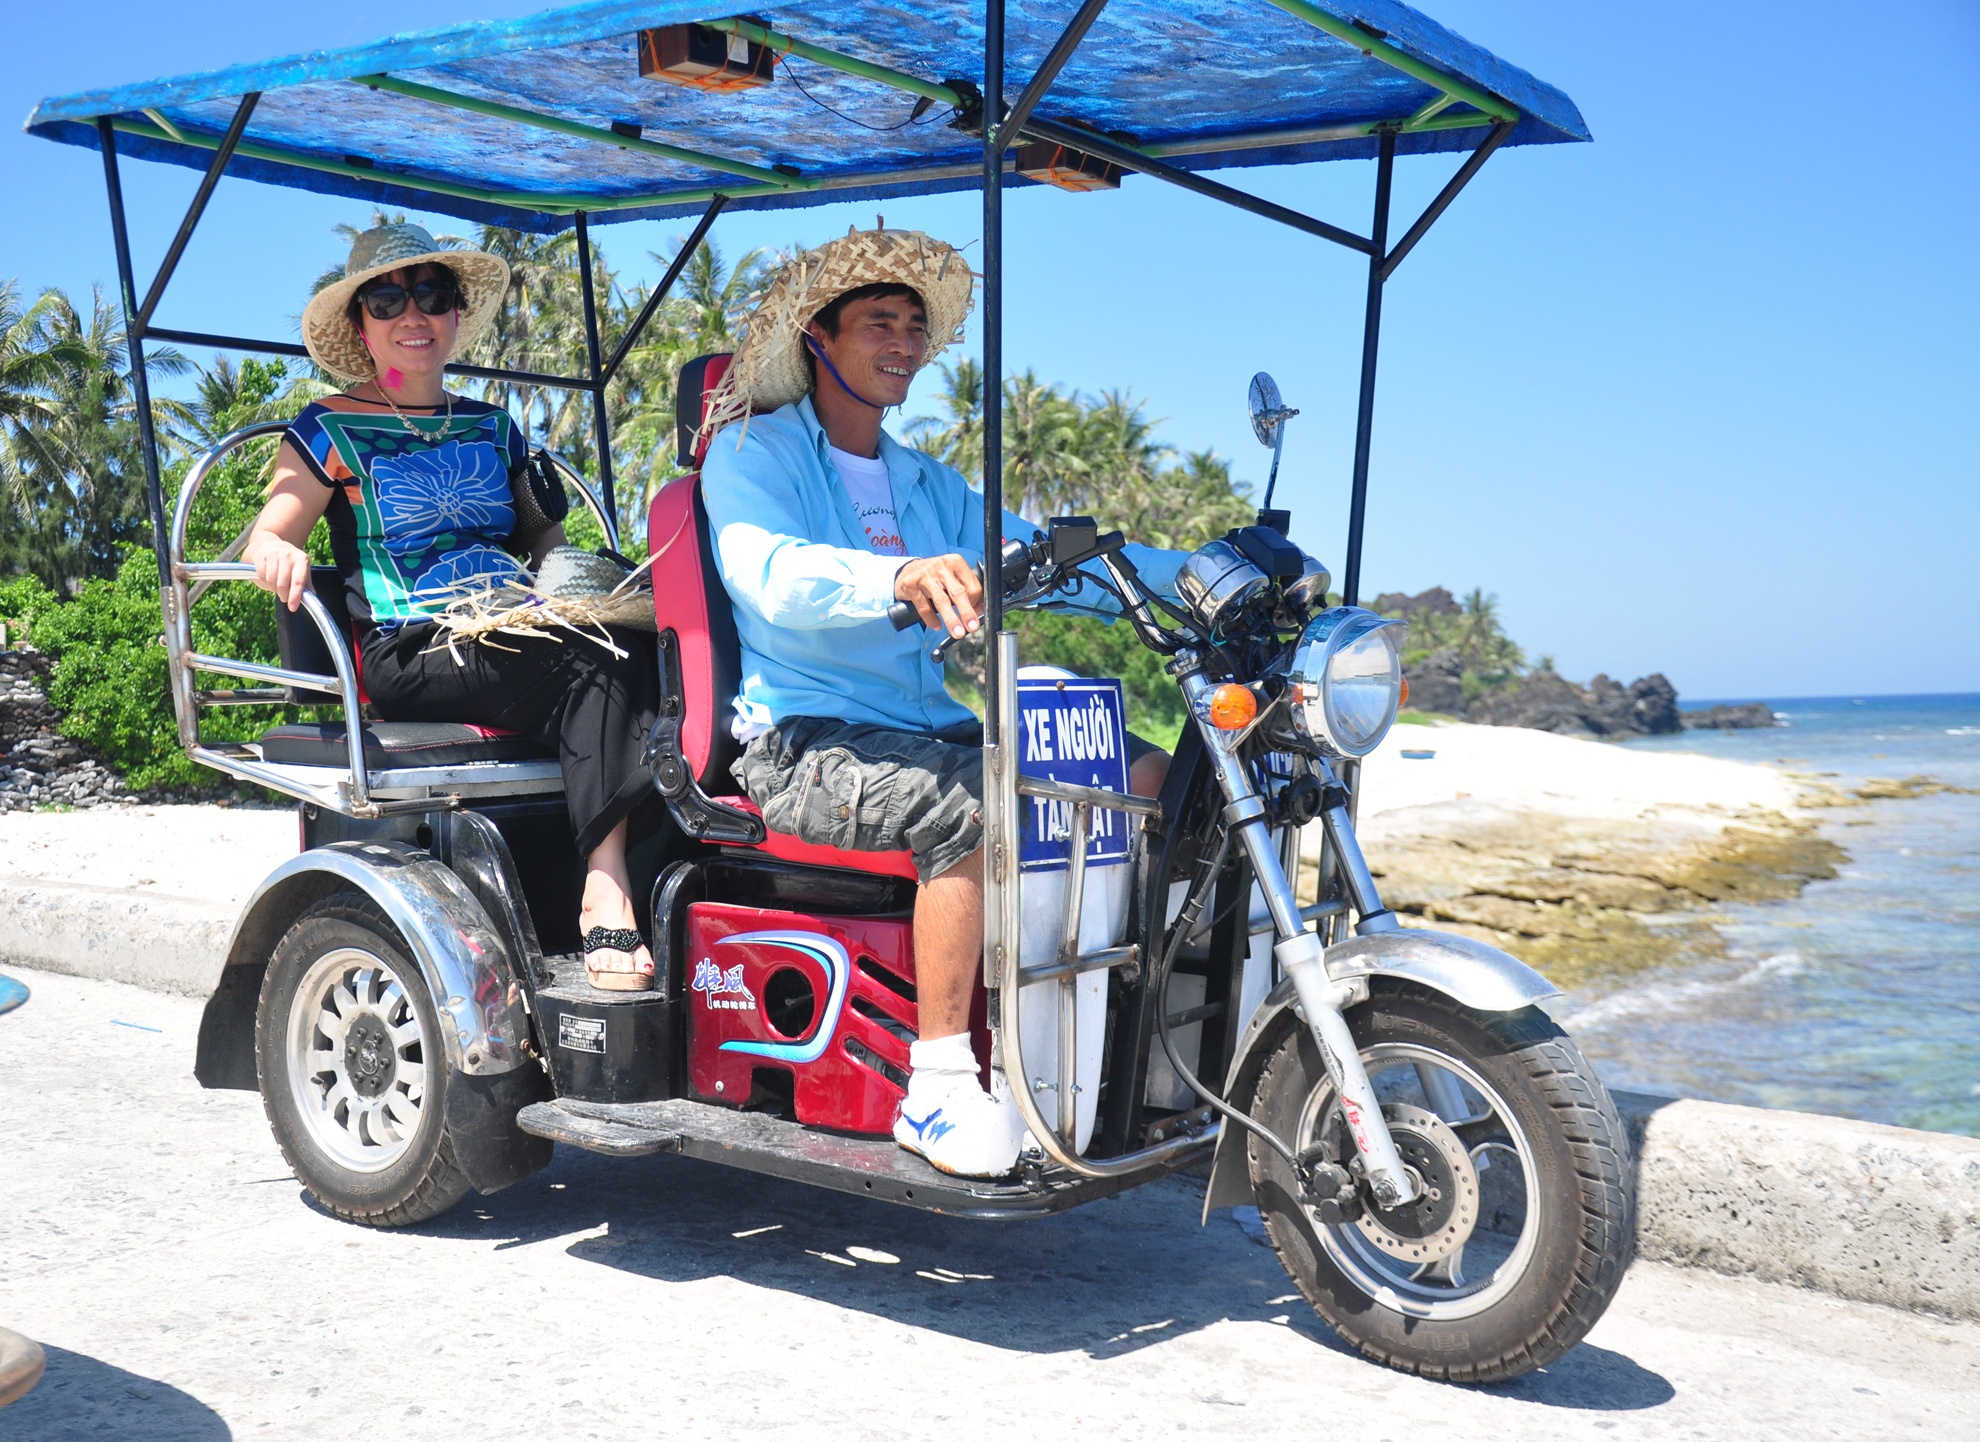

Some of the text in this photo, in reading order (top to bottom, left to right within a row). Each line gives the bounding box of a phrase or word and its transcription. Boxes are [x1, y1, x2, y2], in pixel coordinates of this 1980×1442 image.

[865, 527, 908, 556] oàng
[1023, 694, 1115, 762] XE NGƯỜI
